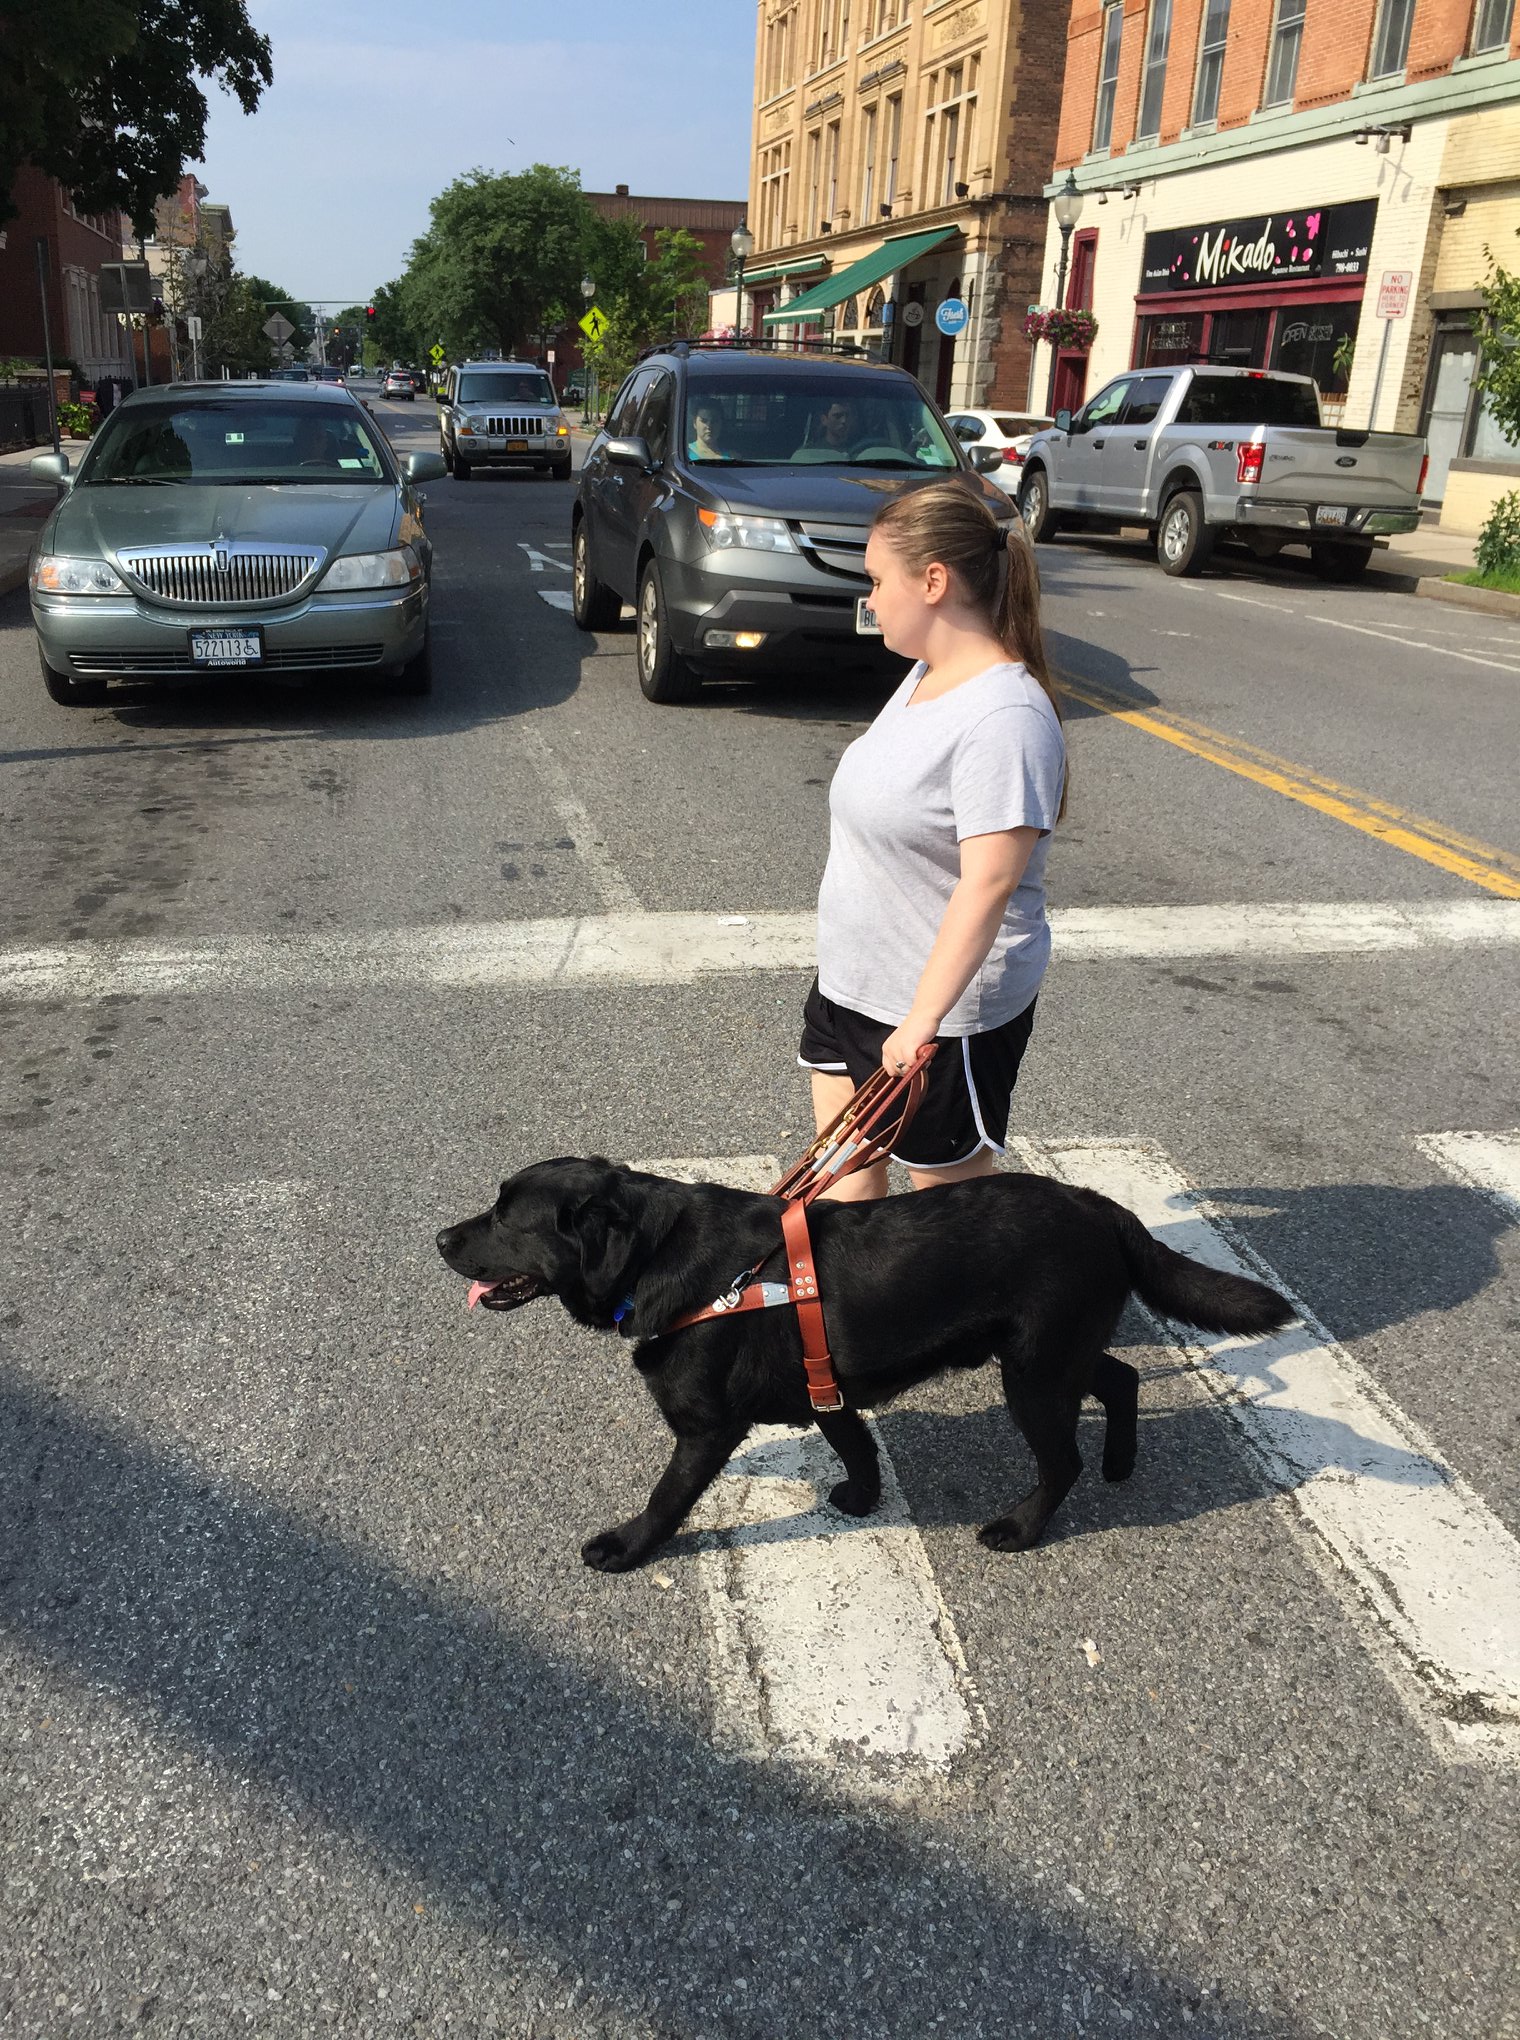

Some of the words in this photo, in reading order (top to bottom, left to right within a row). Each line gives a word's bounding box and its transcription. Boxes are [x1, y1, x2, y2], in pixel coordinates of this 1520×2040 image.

[1195, 218, 1275, 284] Mikado
[1391, 275, 1403, 284] NO
[1382, 285, 1408, 294] PARKING
[196, 640, 241, 657] 522113
[208, 658, 246, 666] Autoworld
